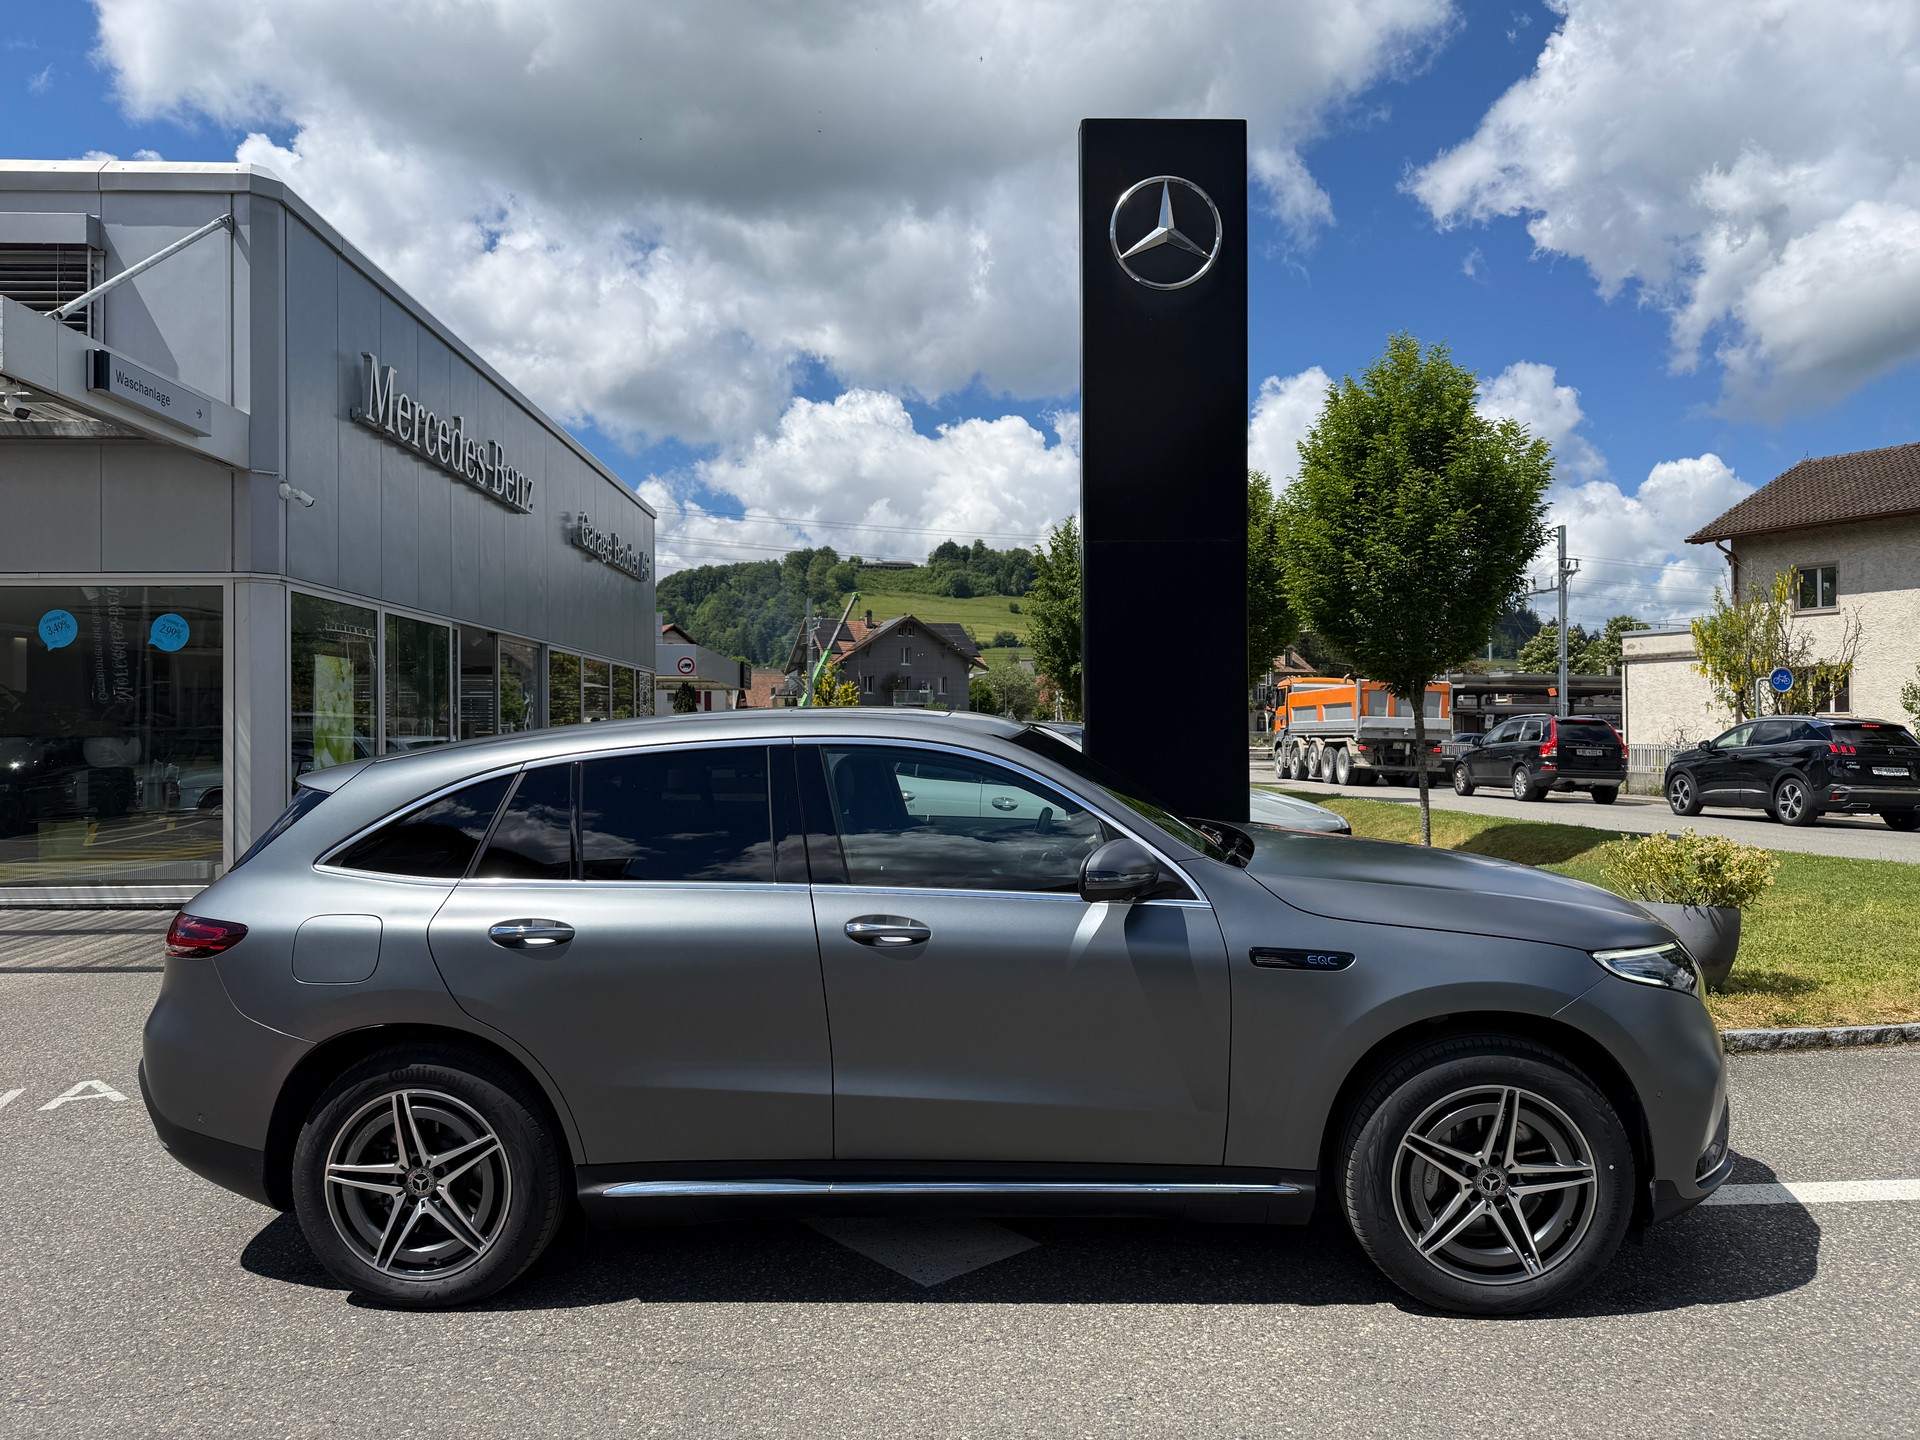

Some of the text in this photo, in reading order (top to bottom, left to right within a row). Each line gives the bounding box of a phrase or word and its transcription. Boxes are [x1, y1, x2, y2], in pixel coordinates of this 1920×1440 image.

[115, 369, 171, 407] Waschanlage
[363, 351, 535, 514] Mercedes-Benz
[580, 511, 613, 563] Garage
[46, 620, 70, 635] 3.49%
[159, 623, 182, 640] 2.99%
[1307, 955, 1338, 965] EQC
